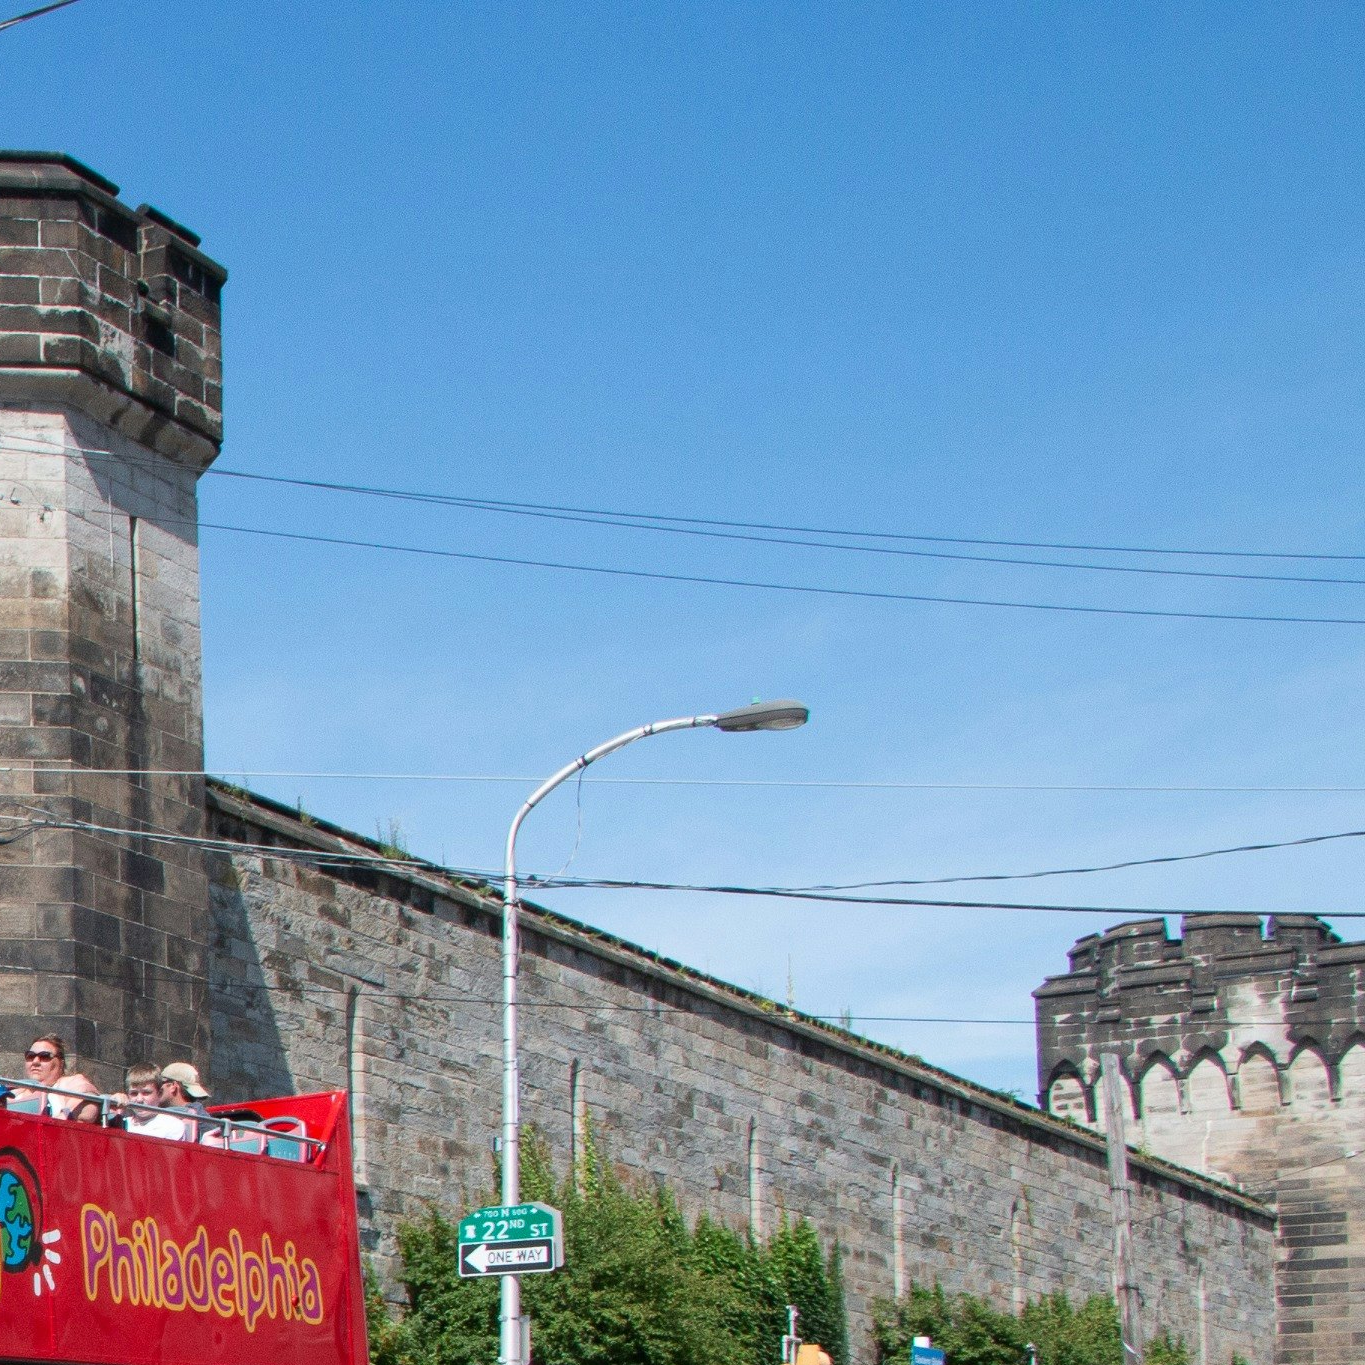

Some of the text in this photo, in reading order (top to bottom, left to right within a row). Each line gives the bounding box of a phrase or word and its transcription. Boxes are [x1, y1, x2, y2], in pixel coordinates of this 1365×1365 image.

[482, 1218, 549, 1240] 22ND ST
[488, 1248, 543, 1264] ONE WAY
[79, 1203, 324, 1334] Philadelphia
